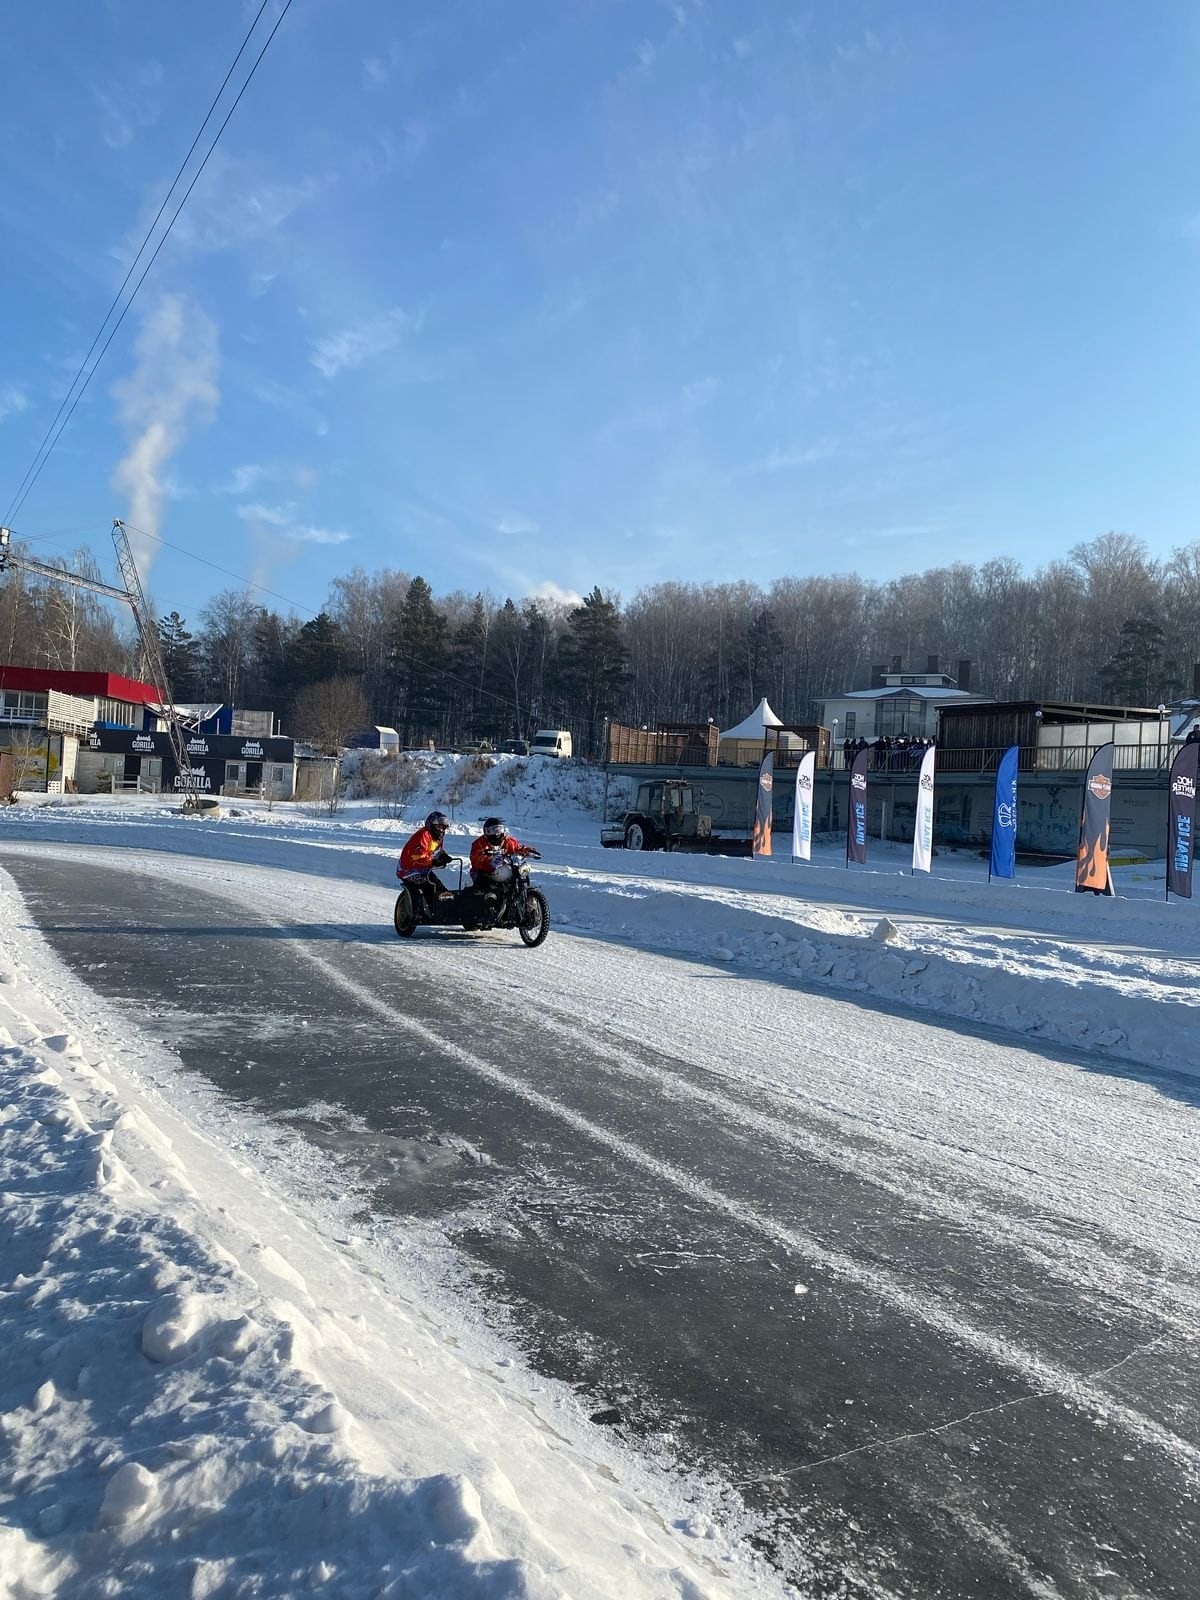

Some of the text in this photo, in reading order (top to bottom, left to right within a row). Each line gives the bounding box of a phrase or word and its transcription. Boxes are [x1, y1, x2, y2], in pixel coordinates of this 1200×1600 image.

[132, 741, 155, 749] GORILLA
[186, 743, 209, 752] GORILLA
[241, 747, 264, 755] GORILLA
[174, 775, 211, 789] GORILLA
